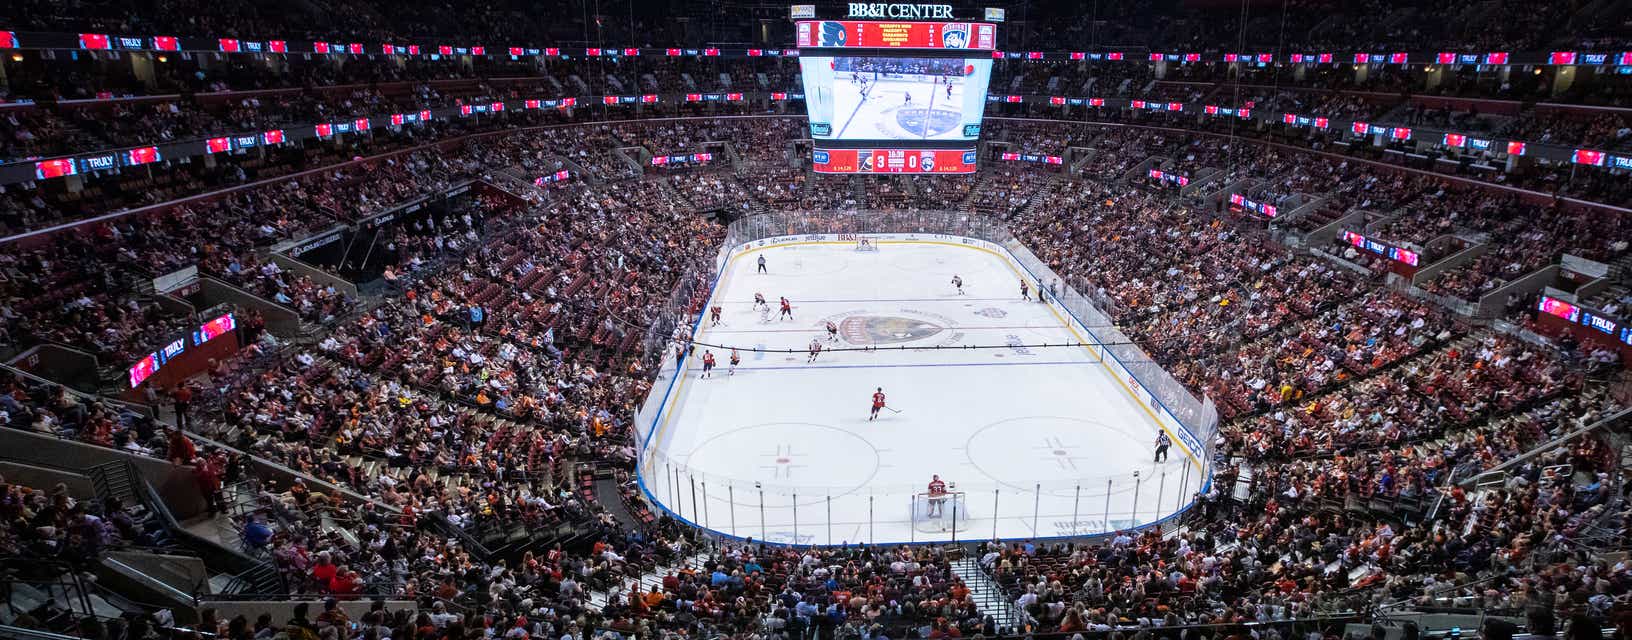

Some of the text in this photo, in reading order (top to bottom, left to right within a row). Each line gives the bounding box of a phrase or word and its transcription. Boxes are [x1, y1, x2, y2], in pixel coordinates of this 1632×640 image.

[848, 3, 954, 18] BB&T CENTER
[120, 38, 141, 47] TRULY
[1586, 54, 1607, 63] TRULY
[238, 136, 254, 145] TRULY
[1473, 139, 1489, 148] TRULY
[88, 156, 113, 167] TRULY
[877, 155, 884, 168] 3
[909, 155, 917, 168] 0
[1371, 241, 1385, 252] TRULY
[1592, 315, 1616, 332] TRULY
[165, 338, 184, 357] TRULY
[1177, 427, 1201, 458] GEICO
